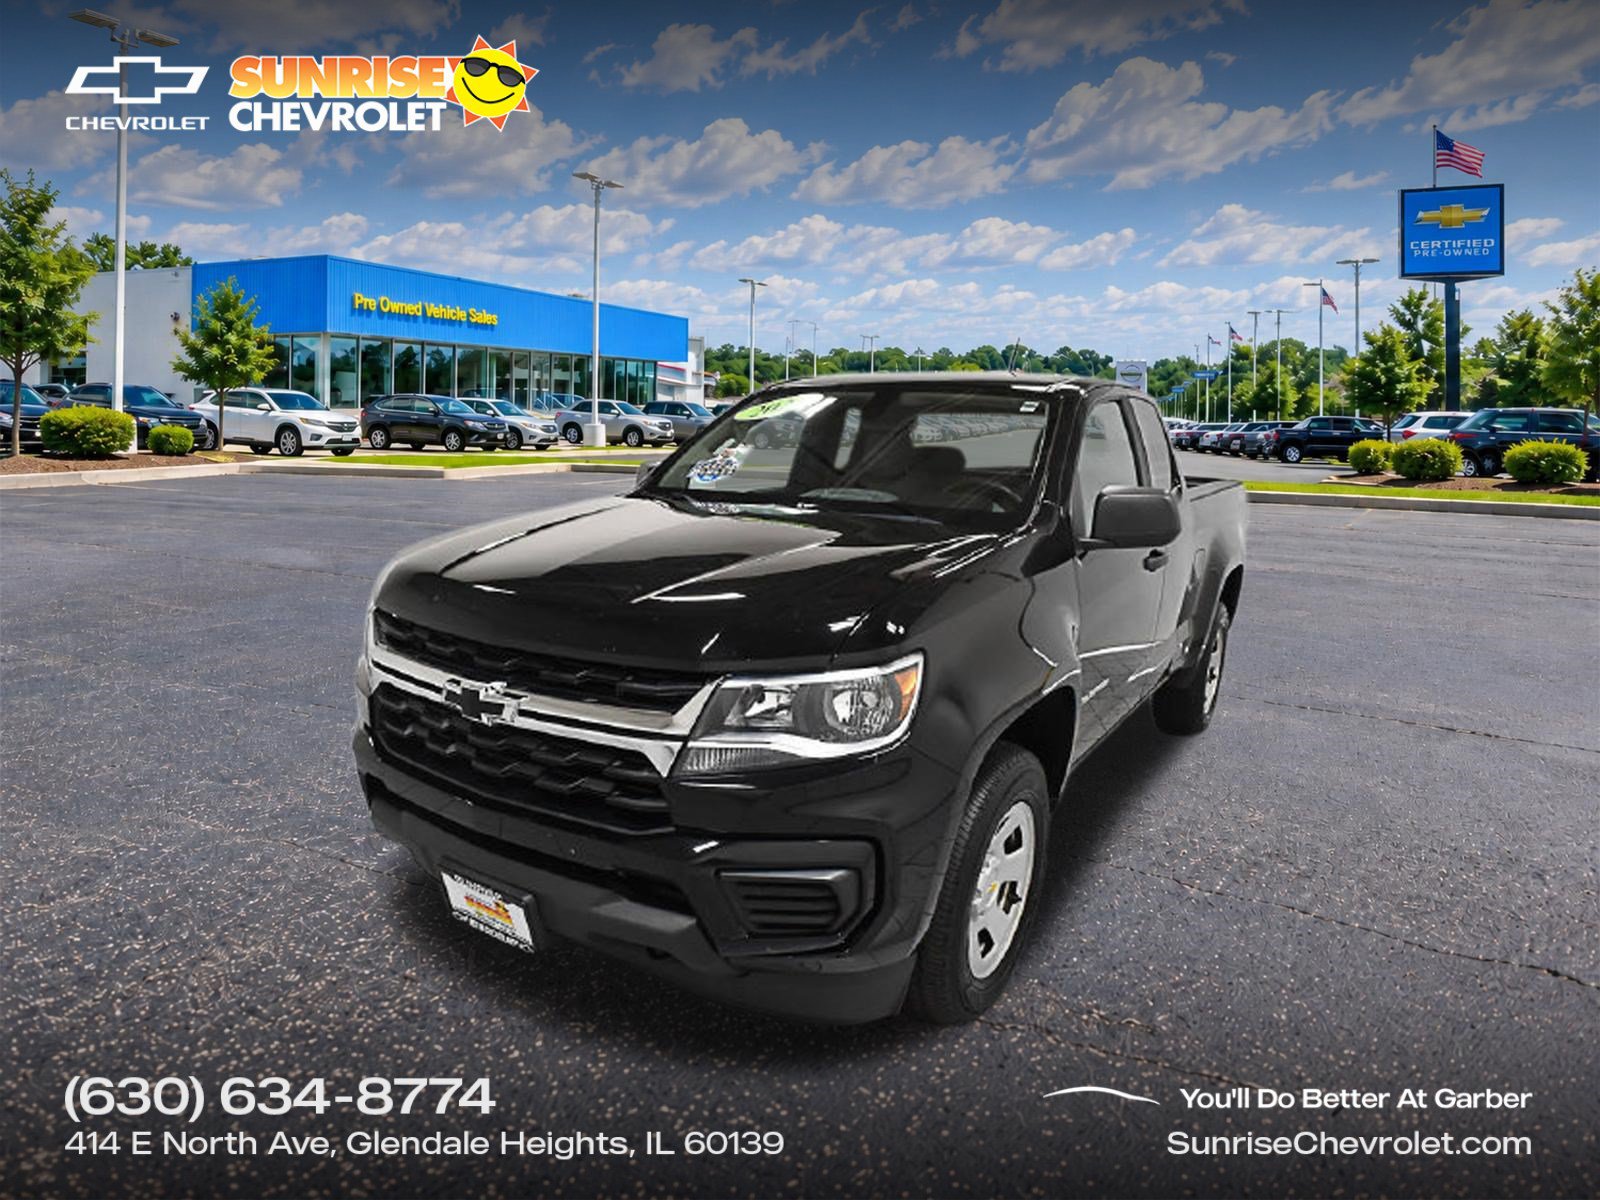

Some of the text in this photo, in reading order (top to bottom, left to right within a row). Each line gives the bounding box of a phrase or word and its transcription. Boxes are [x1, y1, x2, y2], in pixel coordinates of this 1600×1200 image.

[1410, 238, 1495, 250] CERTIFIED
[1414, 248, 1490, 257] PRE-OWNED
[353, 293, 498, 325] Pre Owned Vehicle Sales
